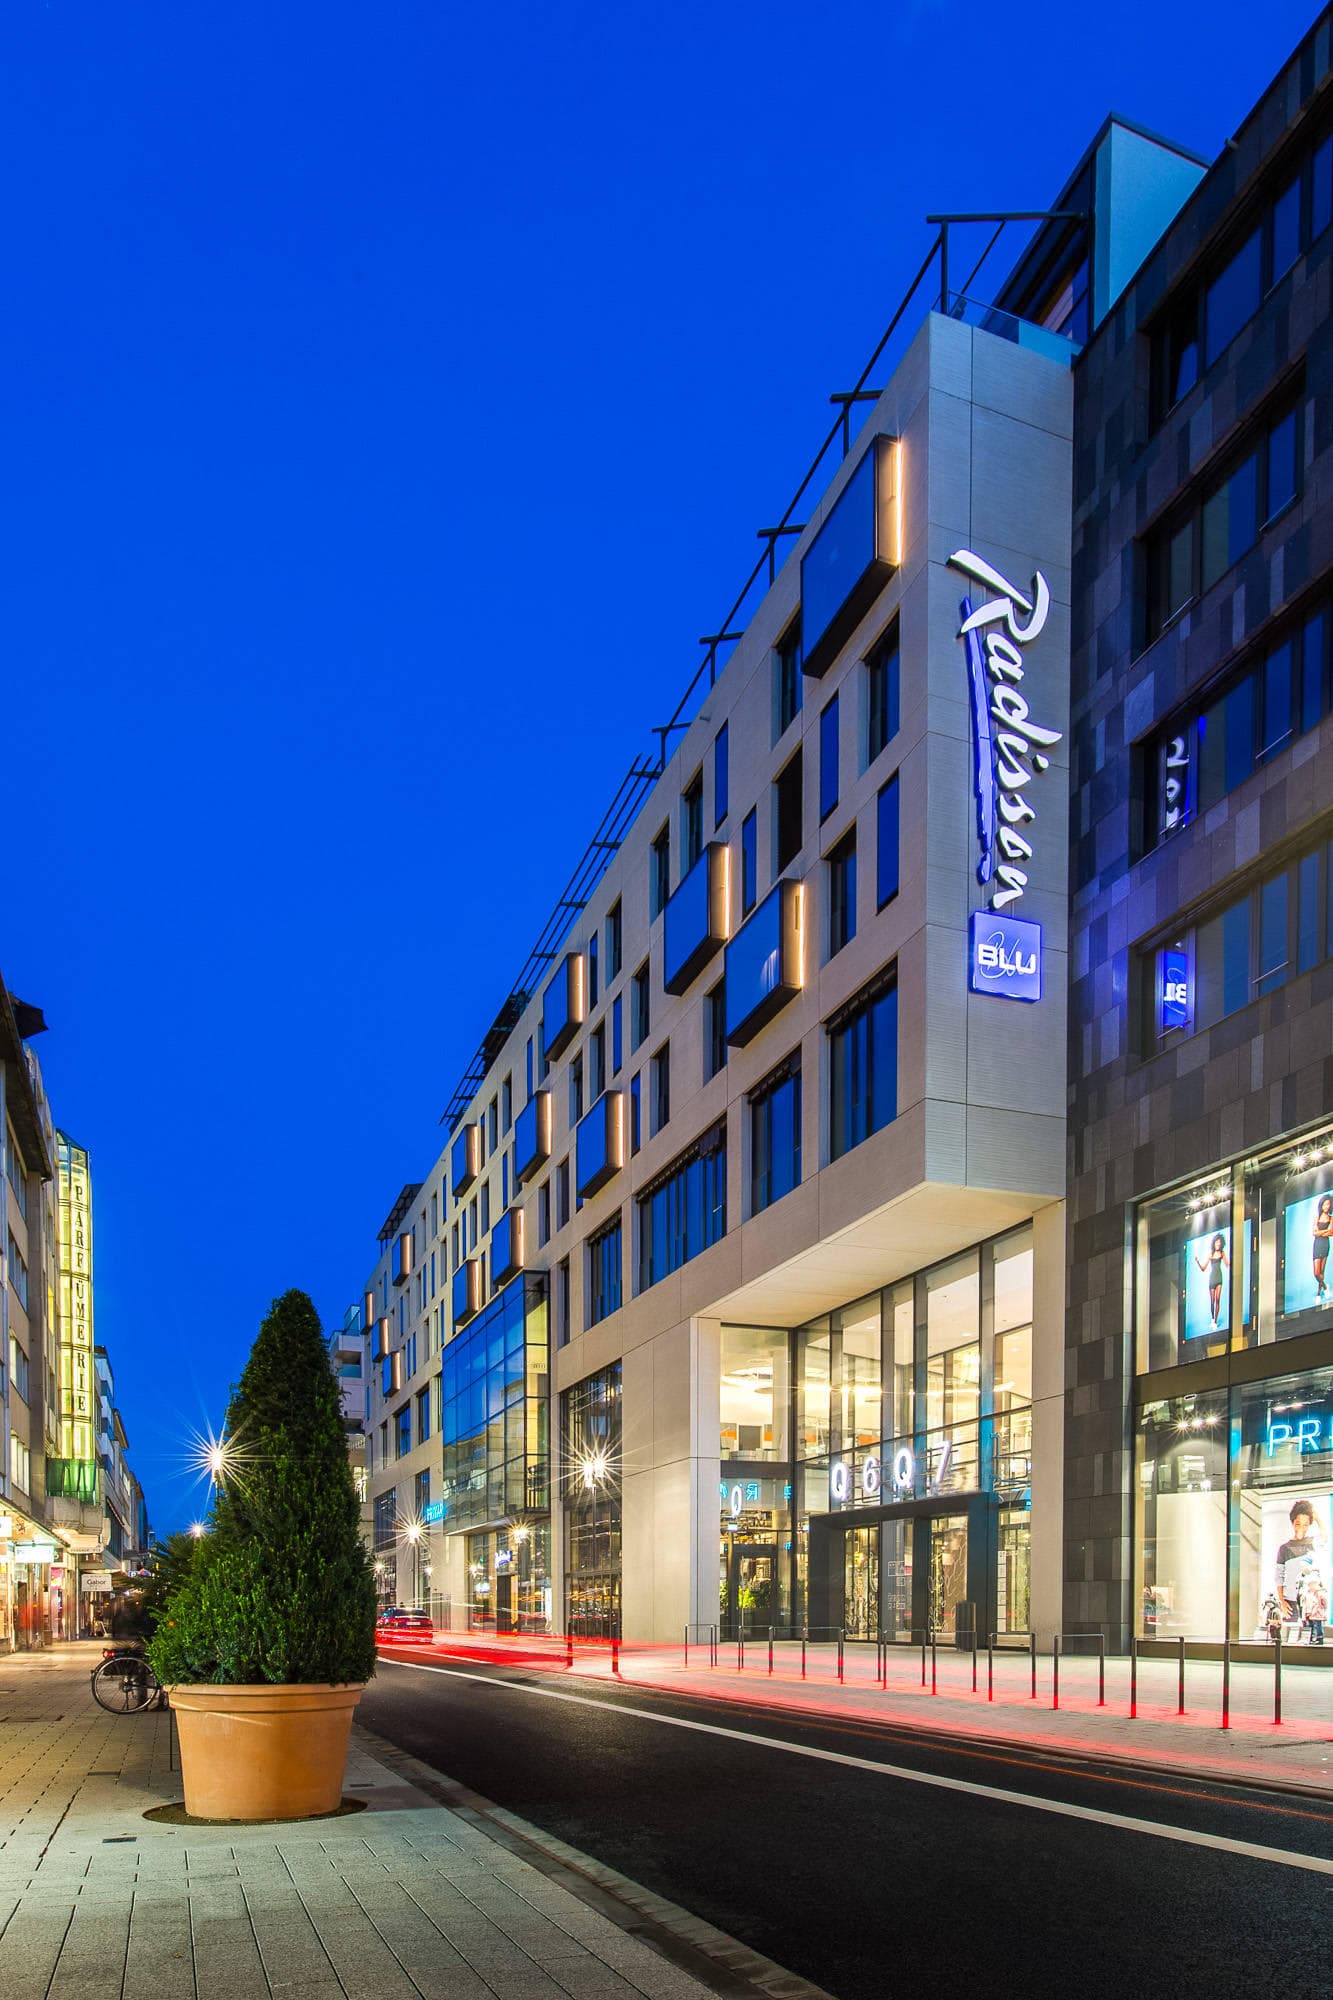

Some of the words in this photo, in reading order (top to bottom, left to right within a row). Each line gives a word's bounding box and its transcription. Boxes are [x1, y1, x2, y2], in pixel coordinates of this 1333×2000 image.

[950, 549, 1063, 908] Radisson
[978, 943, 1036, 975] BLU
[74, 1184, 87, 1412] PARFÜMERIE
[1268, 1415, 1333, 1457] PR
